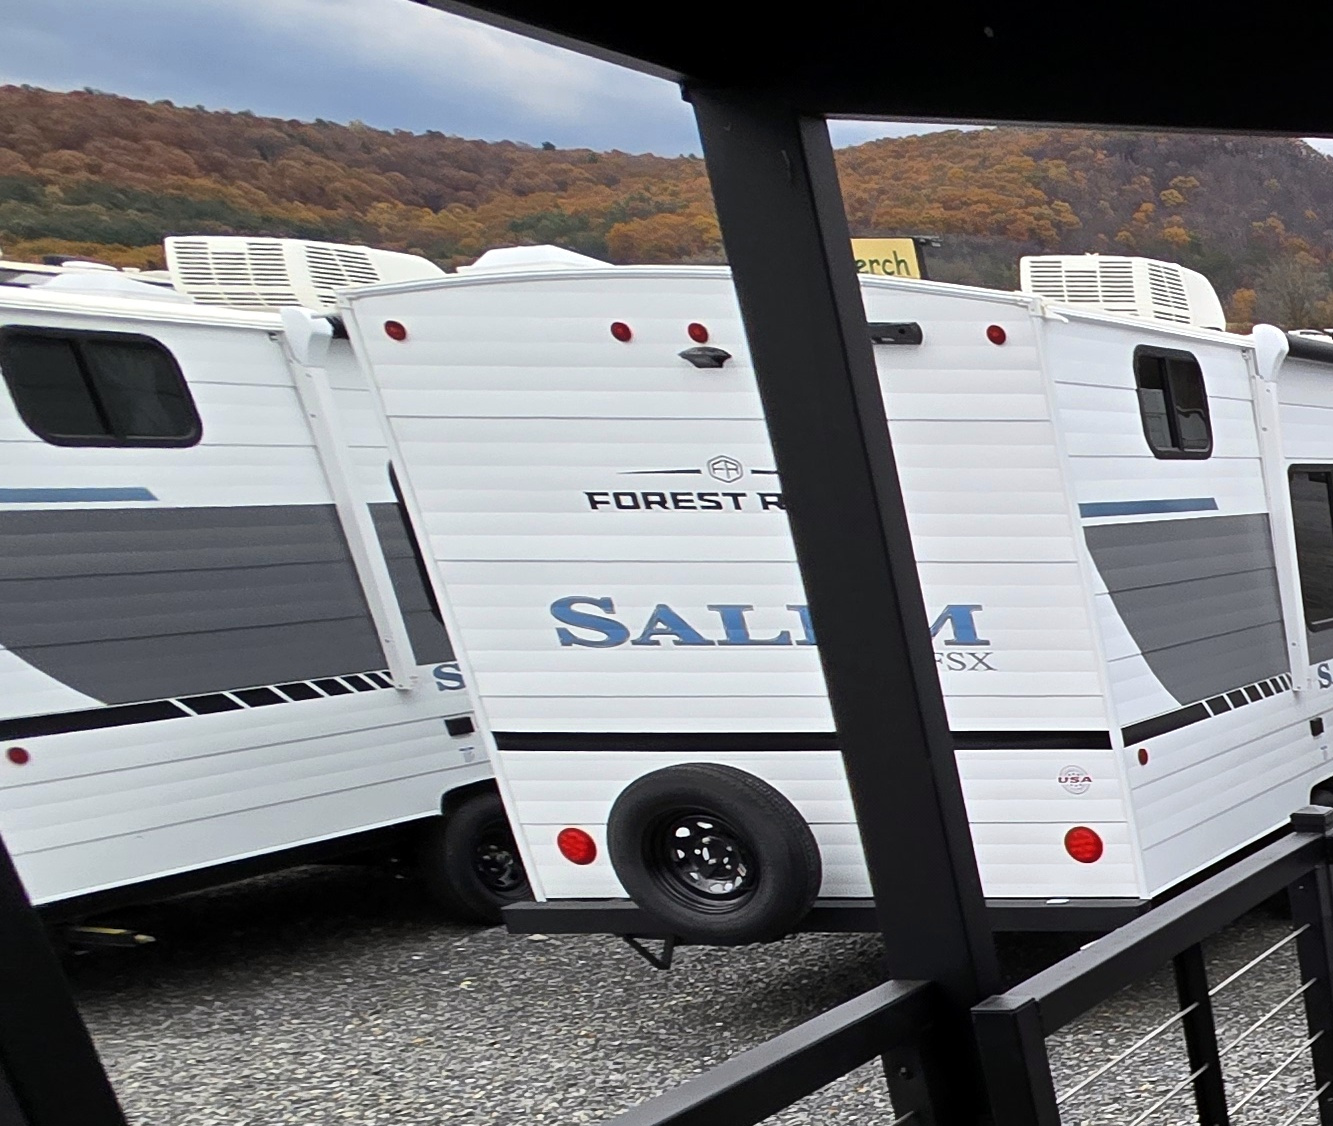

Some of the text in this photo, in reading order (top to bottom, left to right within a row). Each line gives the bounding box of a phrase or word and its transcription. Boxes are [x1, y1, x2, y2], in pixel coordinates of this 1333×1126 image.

[855, 250, 911, 276] erch
[584, 491, 747, 511] FOREST
[1057, 776, 1093, 784] USA
